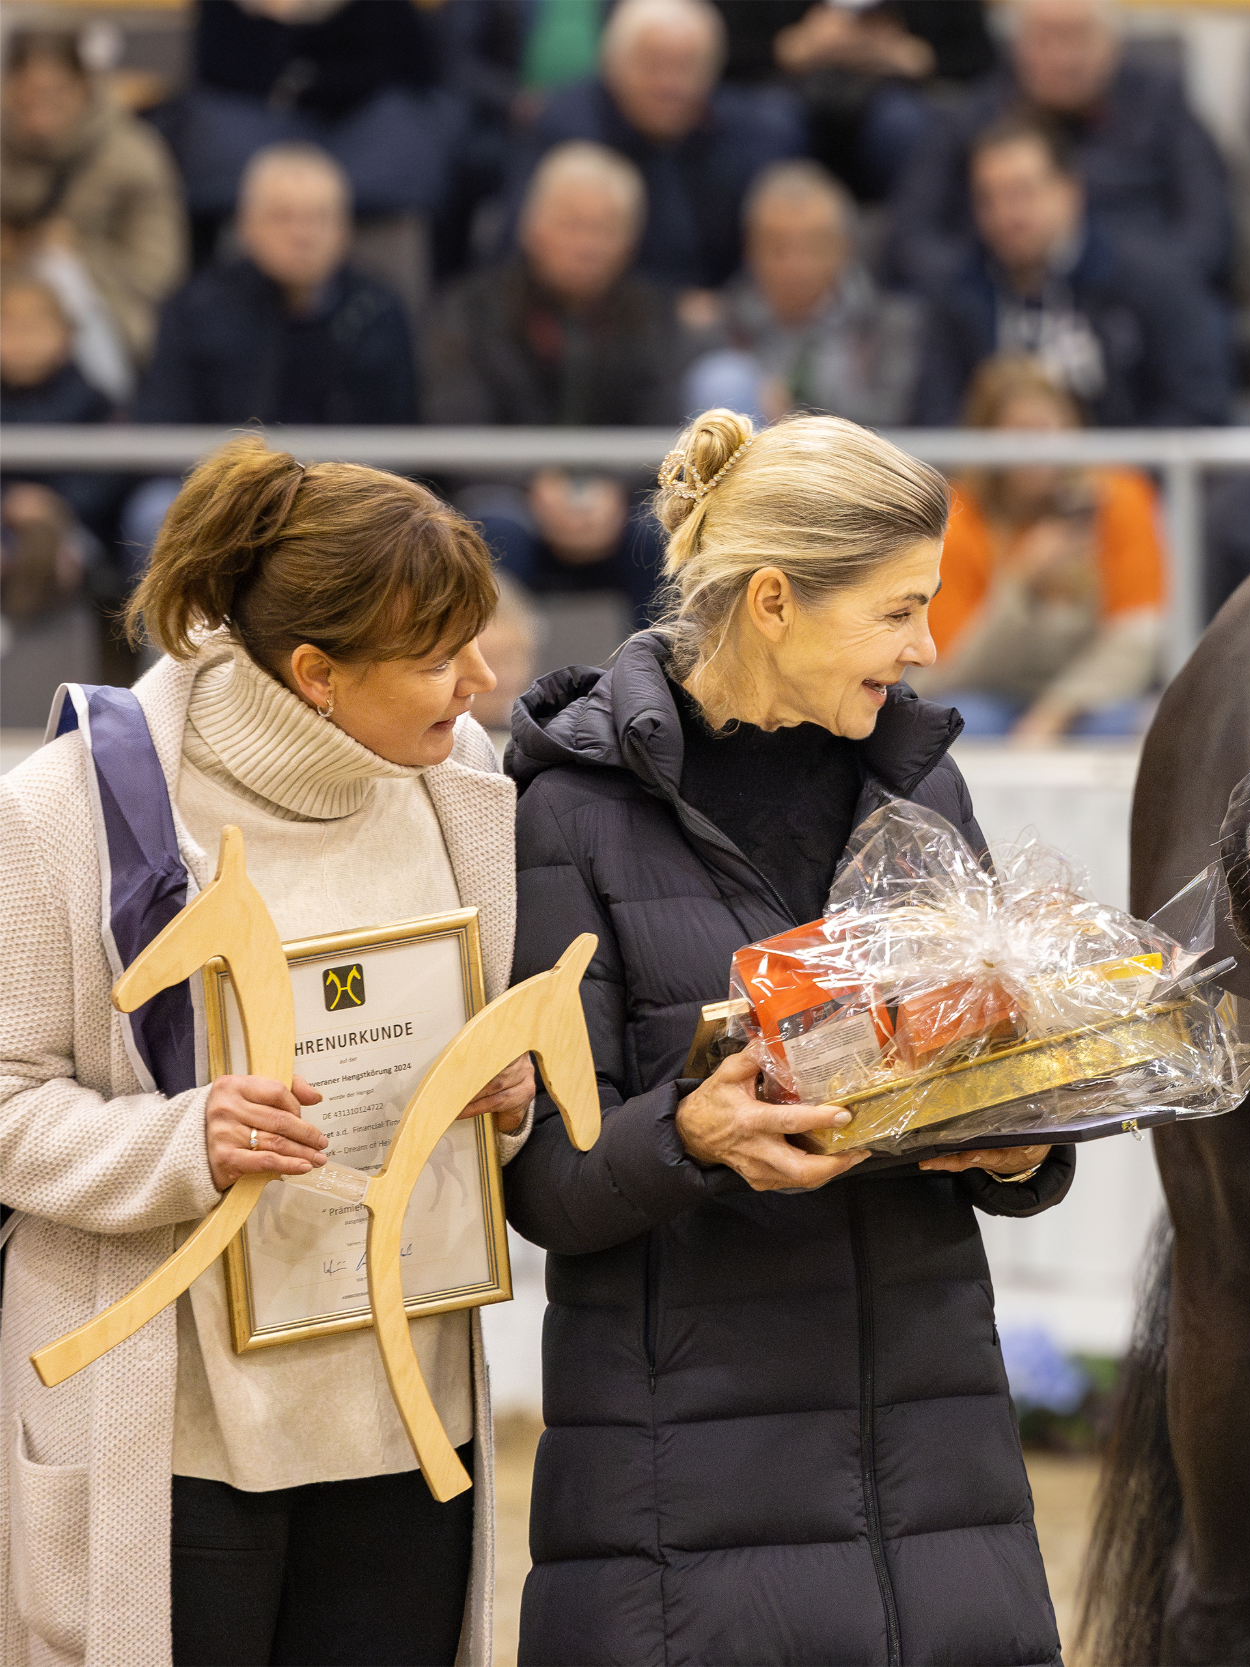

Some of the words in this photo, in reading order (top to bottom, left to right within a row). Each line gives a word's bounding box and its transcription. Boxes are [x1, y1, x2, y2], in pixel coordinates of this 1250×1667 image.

[294, 1022, 414, 1056] HRENURKUNDE
[341, 1067, 392, 1082] Hengstkörung
[393, 1063, 412, 1072] 2024
[322, 1112, 332, 1121] DE
